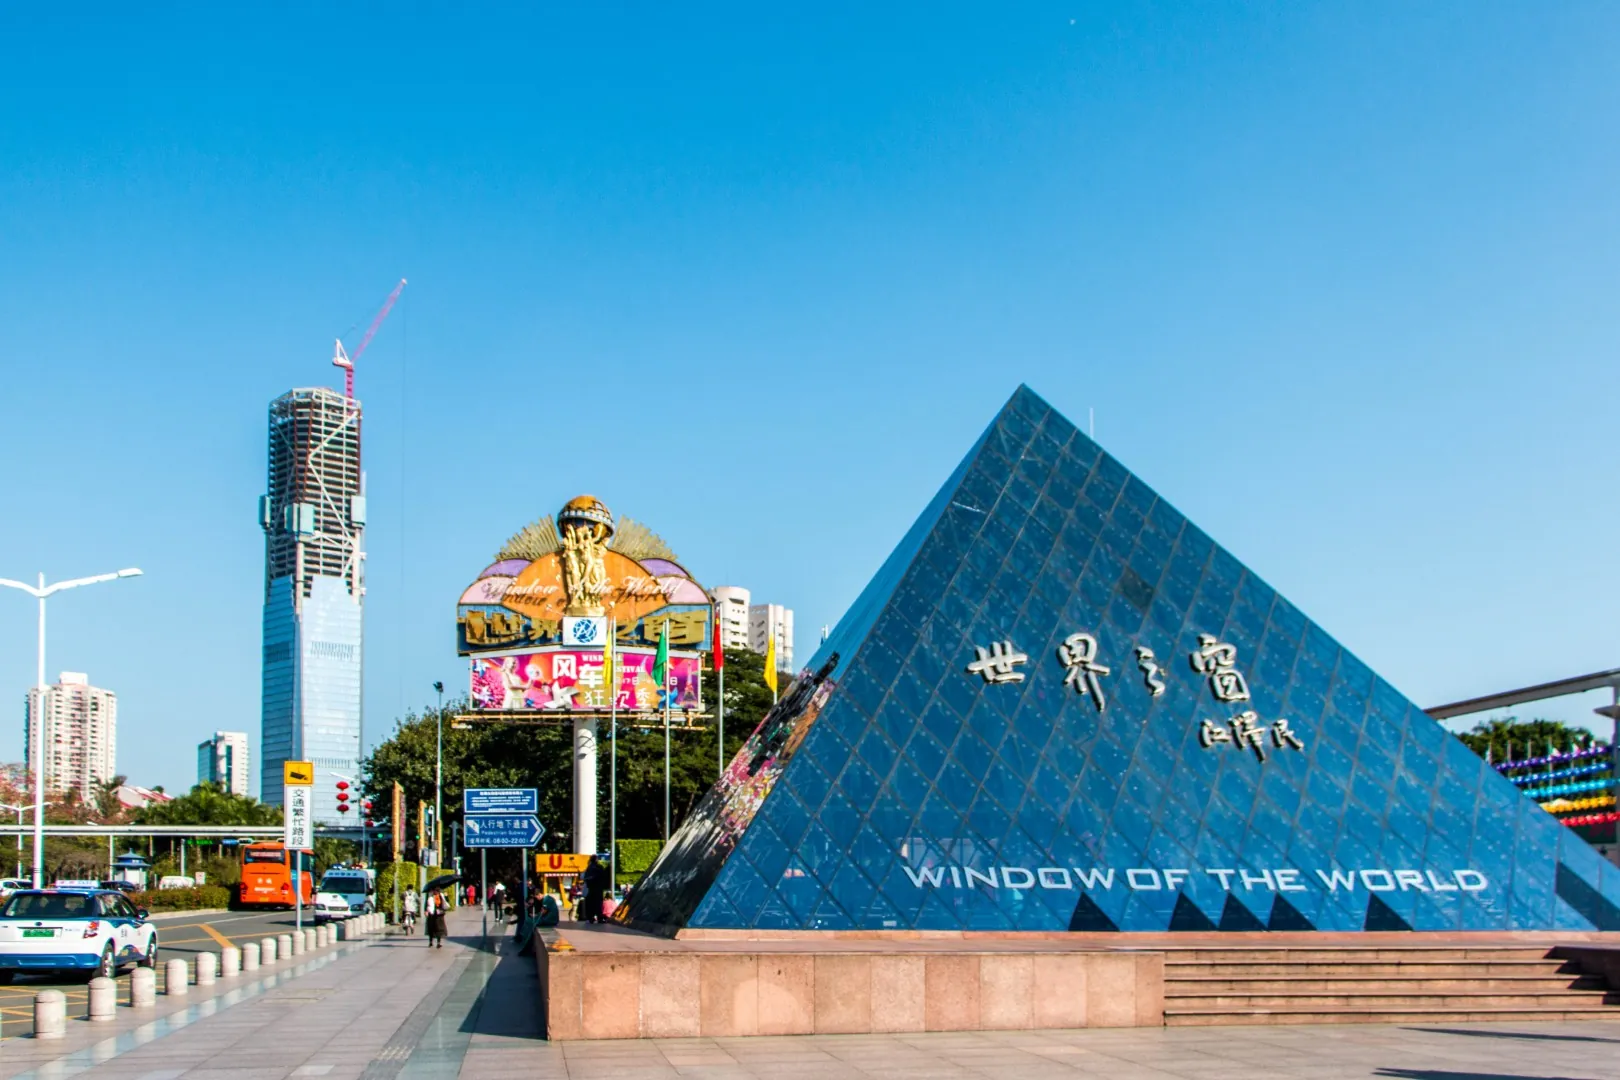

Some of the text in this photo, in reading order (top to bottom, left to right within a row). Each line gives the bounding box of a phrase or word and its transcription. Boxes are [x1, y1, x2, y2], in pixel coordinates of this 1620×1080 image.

[292, 788, 304, 846] 交通繁忙路段
[902, 866, 1489, 892] WINDOW OF THE WORLD
